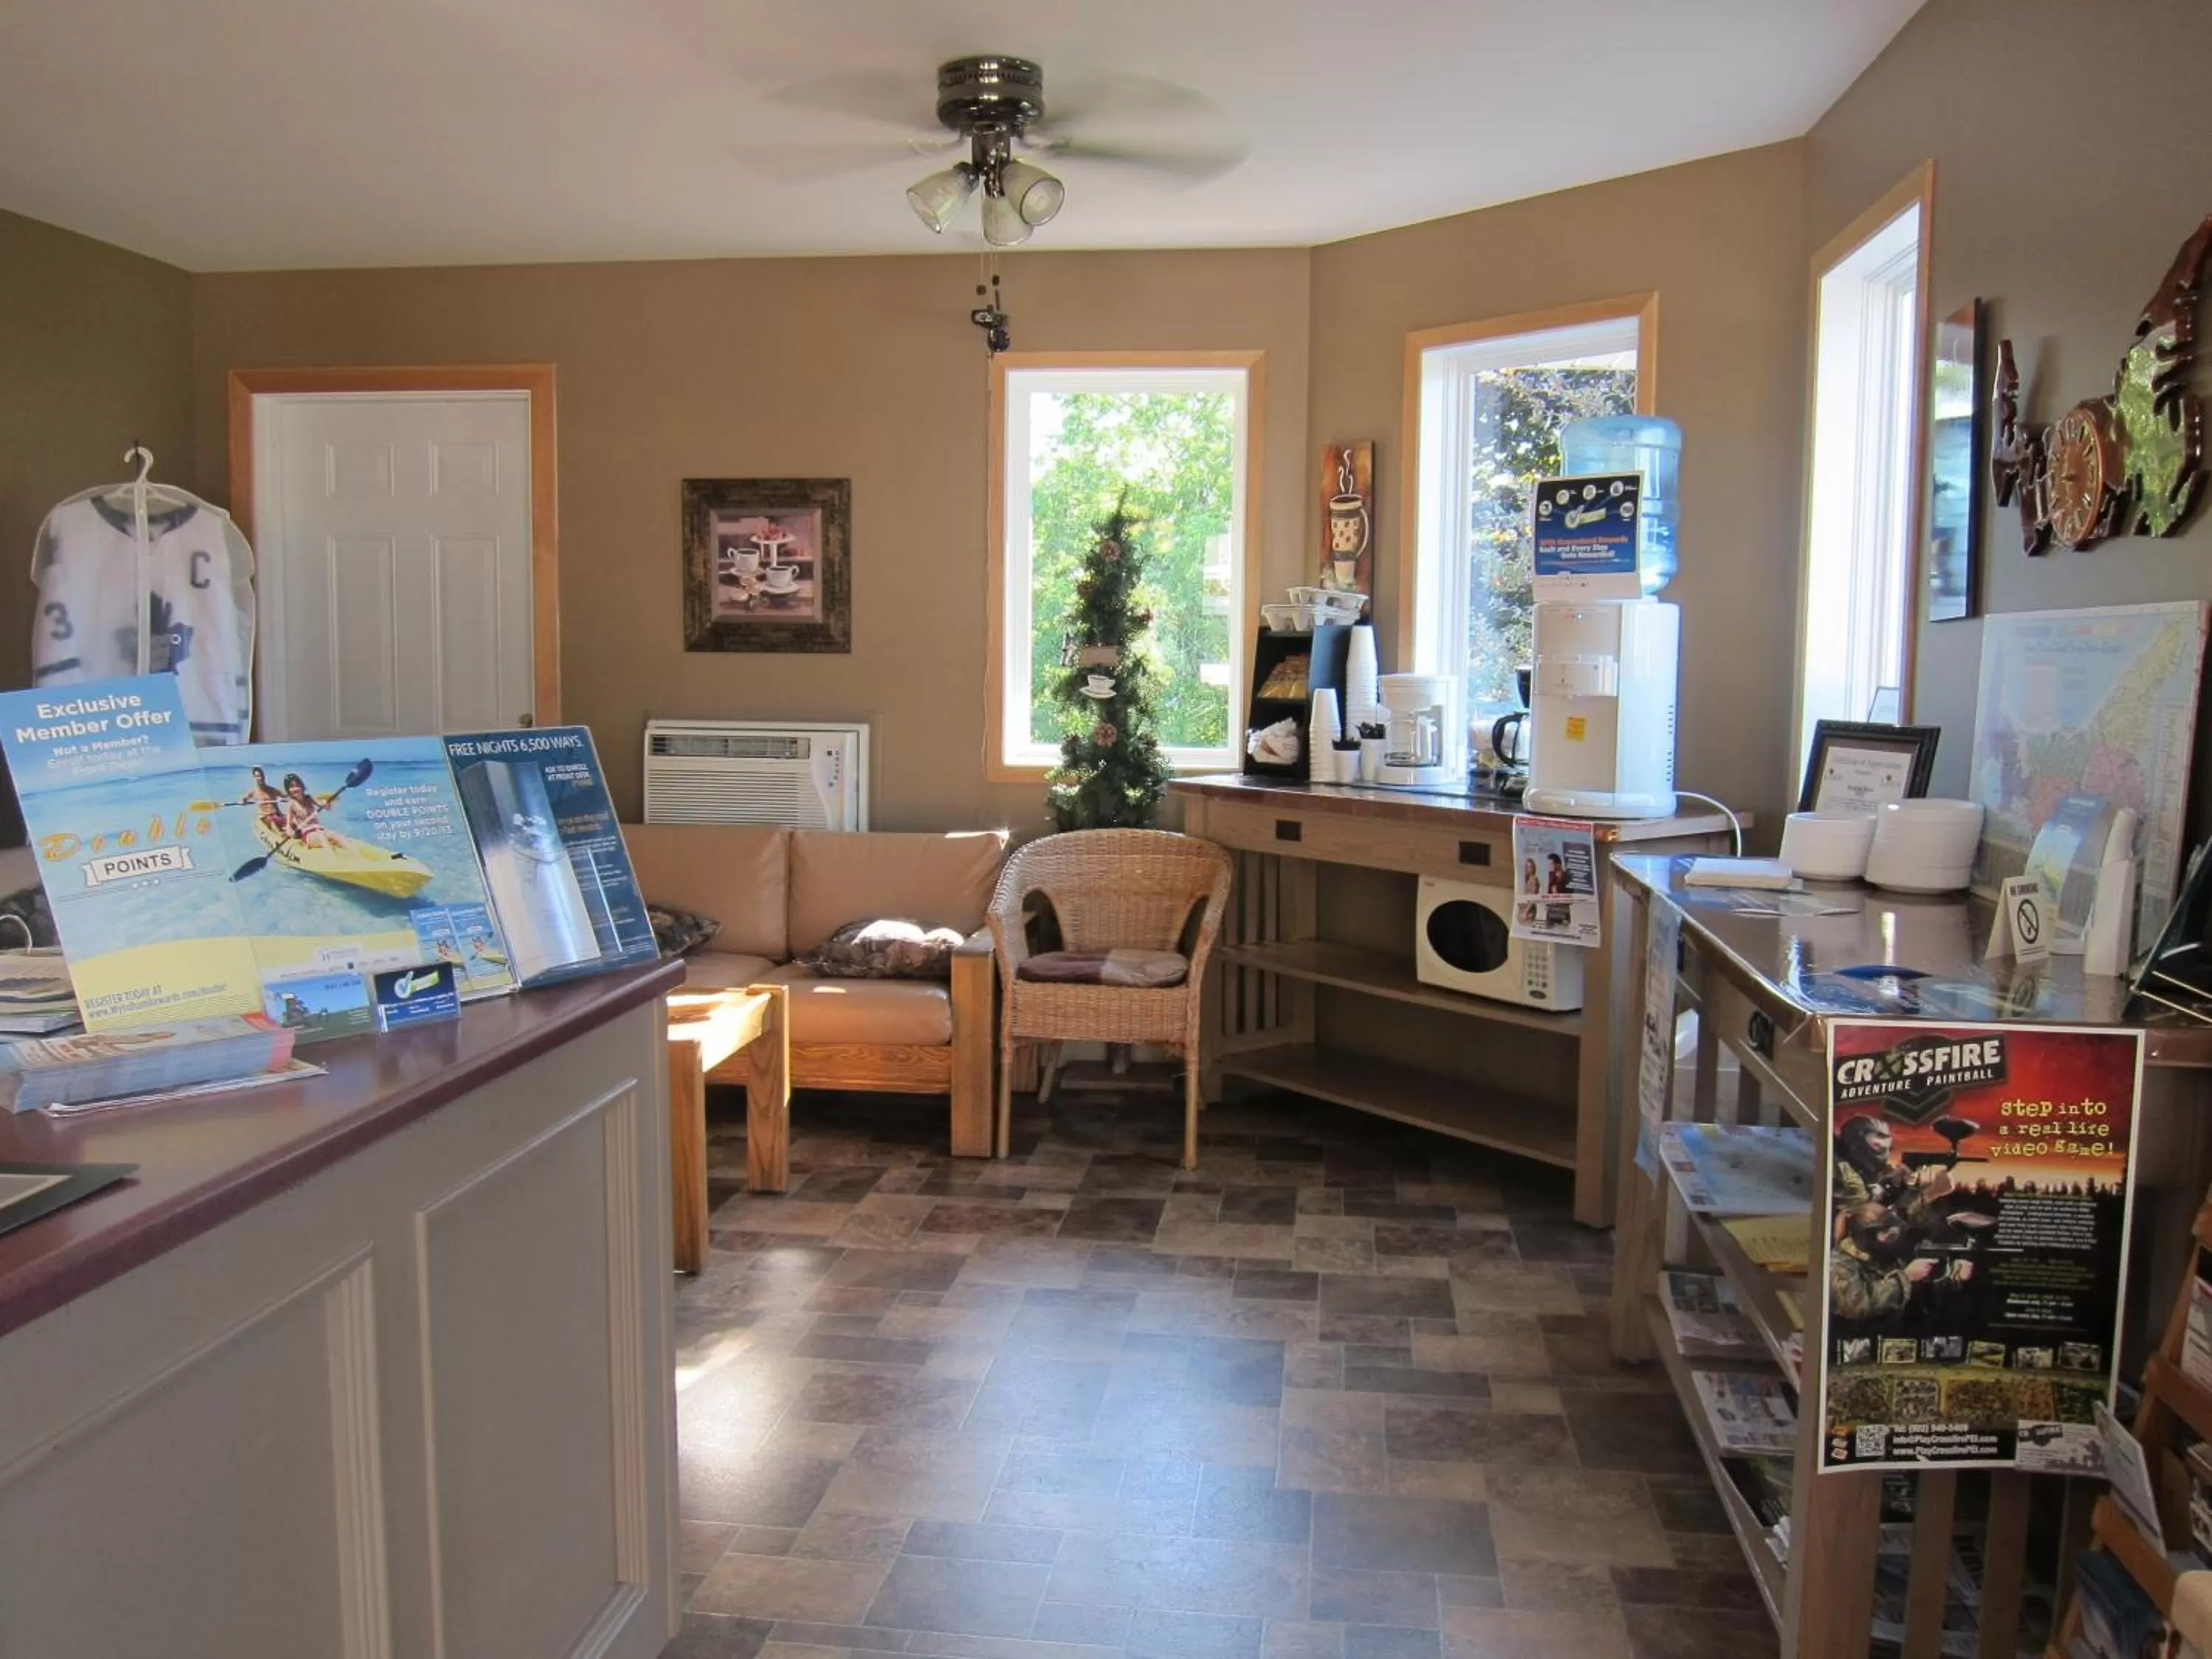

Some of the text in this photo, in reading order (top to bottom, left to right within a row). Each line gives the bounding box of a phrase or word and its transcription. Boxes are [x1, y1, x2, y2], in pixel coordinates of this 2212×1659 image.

[191, 552, 210, 588] C
[44, 602, 73, 640] 3
[37, 695, 142, 720] Exclusive
[16, 710, 173, 743] Member Offer
[52, 734, 150, 757] Not a Member?
[448, 742, 477, 756] FREE
[479, 740, 517, 754] NIGHTS
[520, 738, 549, 754] 6,500
[366, 784, 437, 797] Register today
[366, 804, 449, 819] DOUBLE POINTS
[384, 797, 427, 806] and earn
[389, 819, 411, 831] your
[38, 813, 212, 862] Double
[104, 853, 172, 875] POINTS
[1840, 1069, 1994, 1099] ADVENTURE PAINTBALL
[2000, 1098, 2053, 1117] step
[1999, 1121, 2110, 1137] a real life
[1991, 1140, 2114, 1157] video game!
